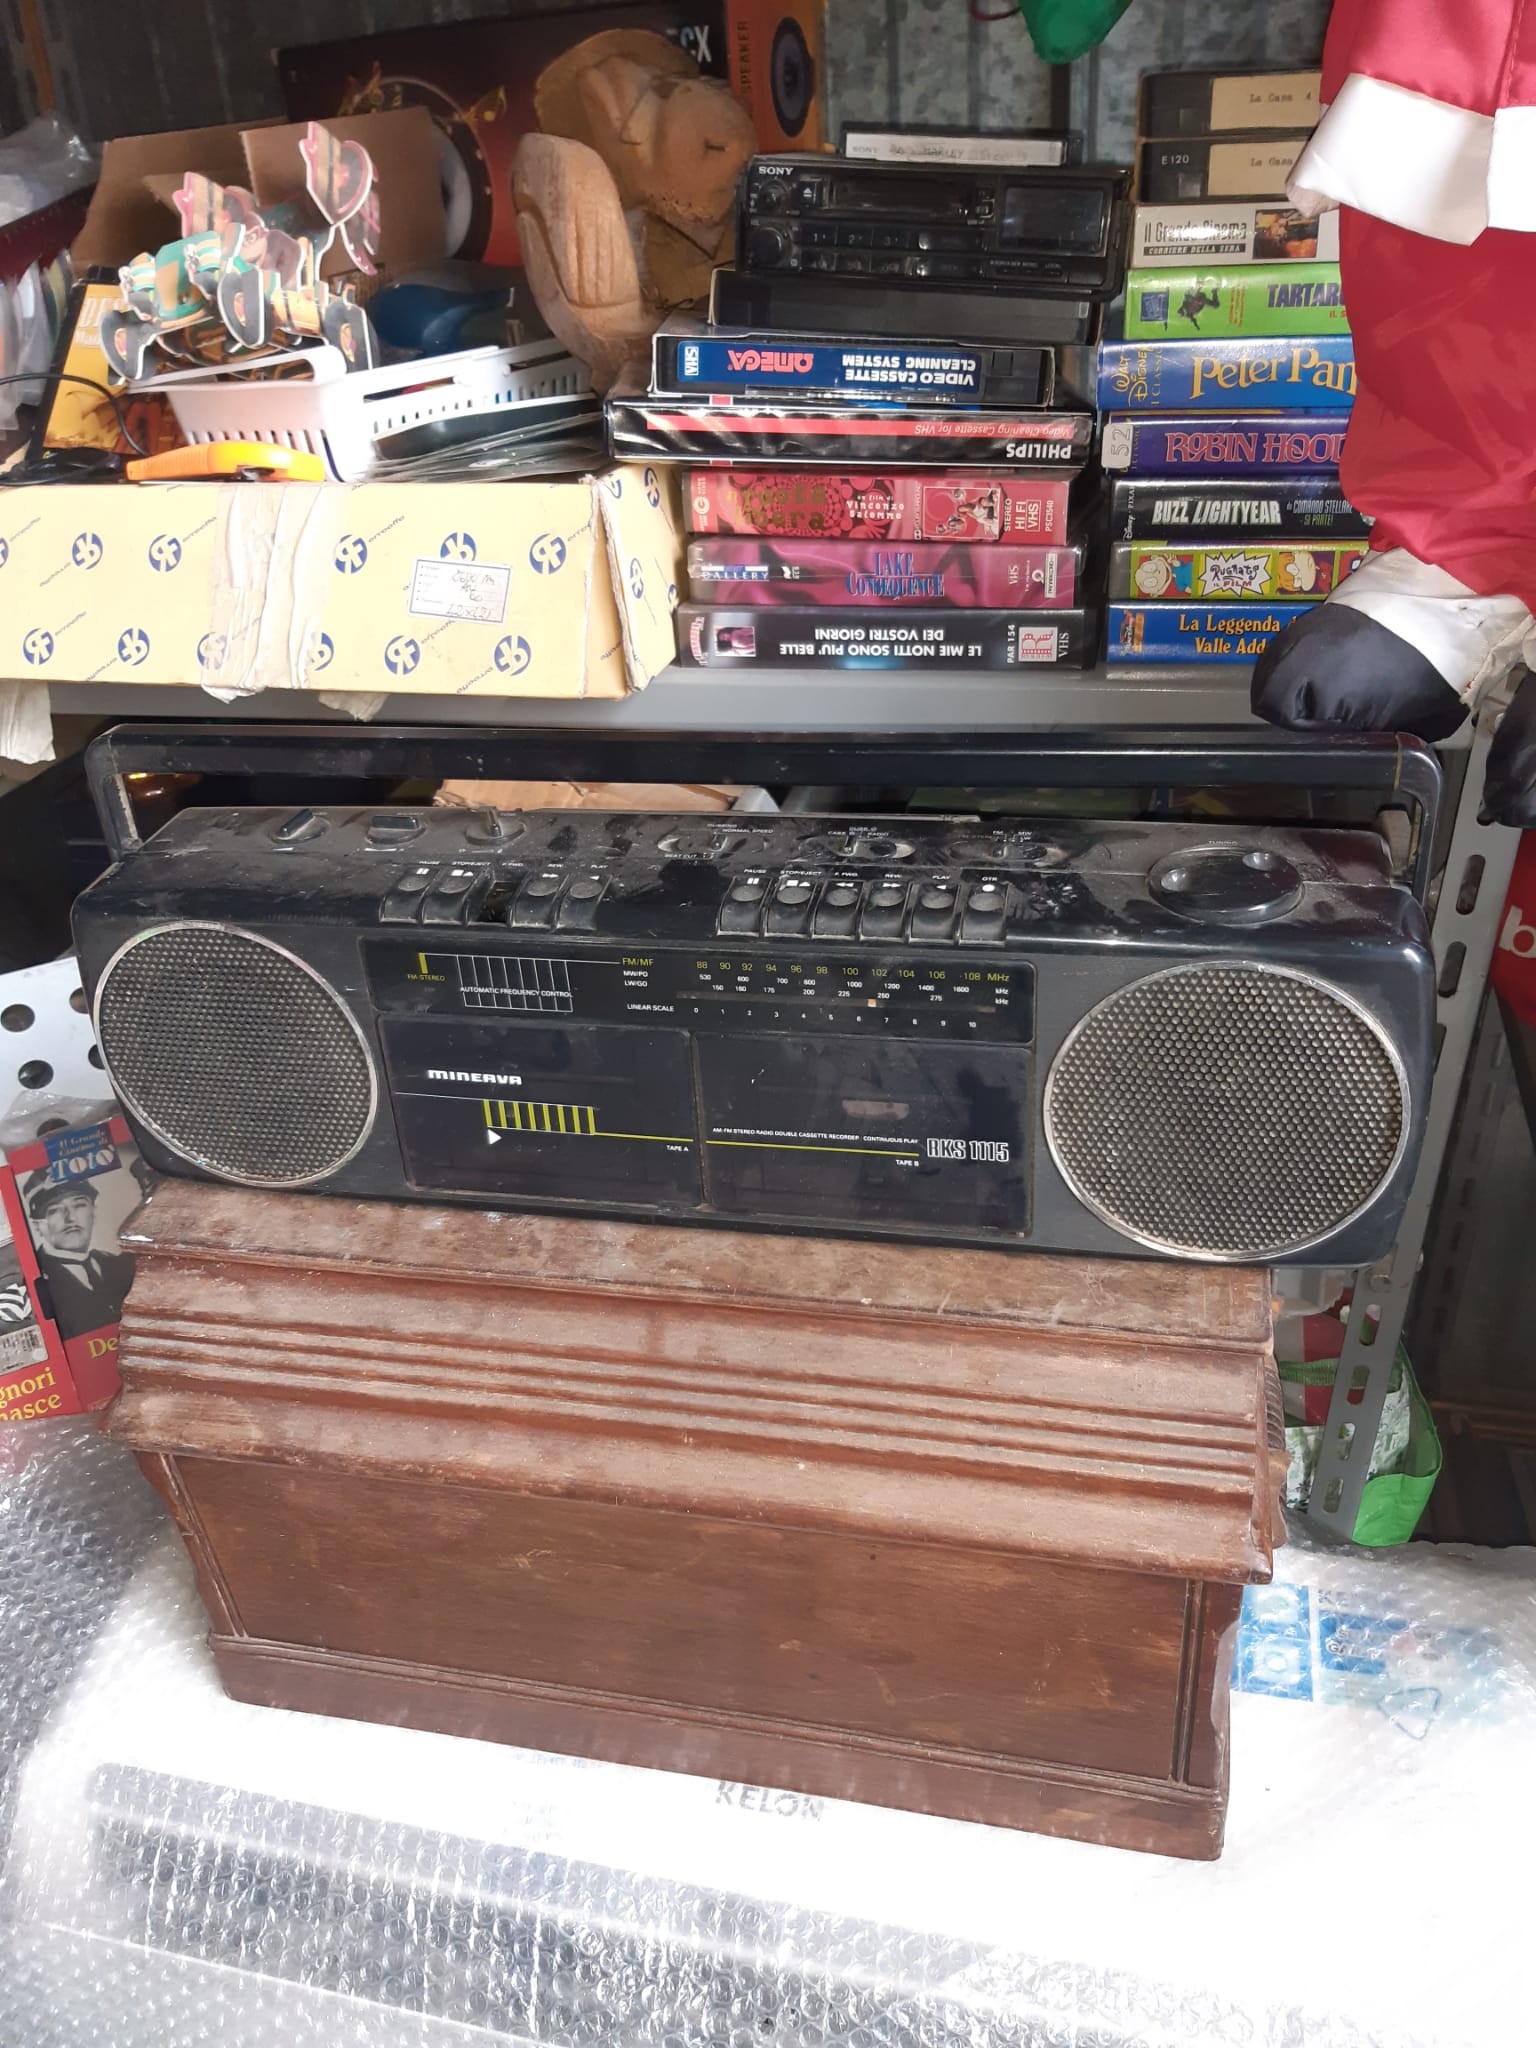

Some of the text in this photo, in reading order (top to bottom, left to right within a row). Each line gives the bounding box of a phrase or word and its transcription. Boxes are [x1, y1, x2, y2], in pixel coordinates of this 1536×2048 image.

[737, 20, 752, 93] SPEAKER
[758, 166, 794, 176] SONY
[1190, 245, 1216, 254] DELLA
[1218, 244, 1241, 254] SERA
[684, 346, 699, 376] VHS
[842, 354, 976, 372] CLEANING SYSTEM
[845, 369, 975, 387] VIDEO CASSETTE
[1111, 354, 1132, 393] WALT
[1189, 347, 1358, 400] Peter Pan
[914, 423, 936, 434] VHS
[937, 424, 953, 435] for
[954, 424, 996, 437] Cassette
[998, 425, 1040, 439] Cleaning
[1006, 443, 1072, 459] PHILIPS
[1111, 427, 1132, 458] 52
[1165, 431, 1259, 464] ROBIN
[845, 500, 905, 510] Vincenzo
[1151, 500, 1283, 526] BUZZ LIGHTYEAR
[1003, 497, 1012, 532] STEREO
[1015, 500, 1026, 530] HI FI
[1027, 502, 1039, 530] VHS
[1123, 514, 1136, 541] Disney
[875, 551, 914, 577] LAKE
[1009, 564, 1020, 586] VHS
[1222, 579, 1253, 588] FILM
[845, 573, 946, 600] CONSEQUENCE
[1179, 614, 1281, 636] La Leggenda
[814, 628, 945, 641] DEI VOSTRI GIORNI
[779, 643, 815, 655] BELLE
[847, 643, 890, 656] SONO
[894, 644, 935, 656] NOTTI
[938, 645, 964, 657] MIE
[967, 645, 982, 657] LE
[1007, 624, 1016, 664] PAR 154
[1058, 631, 1069, 658] VHS
[1194, 636, 1233, 655] Valle
[621, 957, 1010, 982] FM/MF 88 90 92 94 96 98 100 102 104 106 108 MHz
[460, 986, 574, 998] AUTOMATIC FREQUENCY CONTROL
[427, 1069, 523, 1086] MINERVA
[798, 1131, 827, 1139] CASSETTE
[828, 1133, 860, 1141] RECORDER
[862, 1135, 903, 1143] CONTINUOUS
[666, 1144, 683, 1152] TAPE
[926, 1137, 1010, 1163] RKS 1115
[895, 1159, 913, 1167] TAPE
